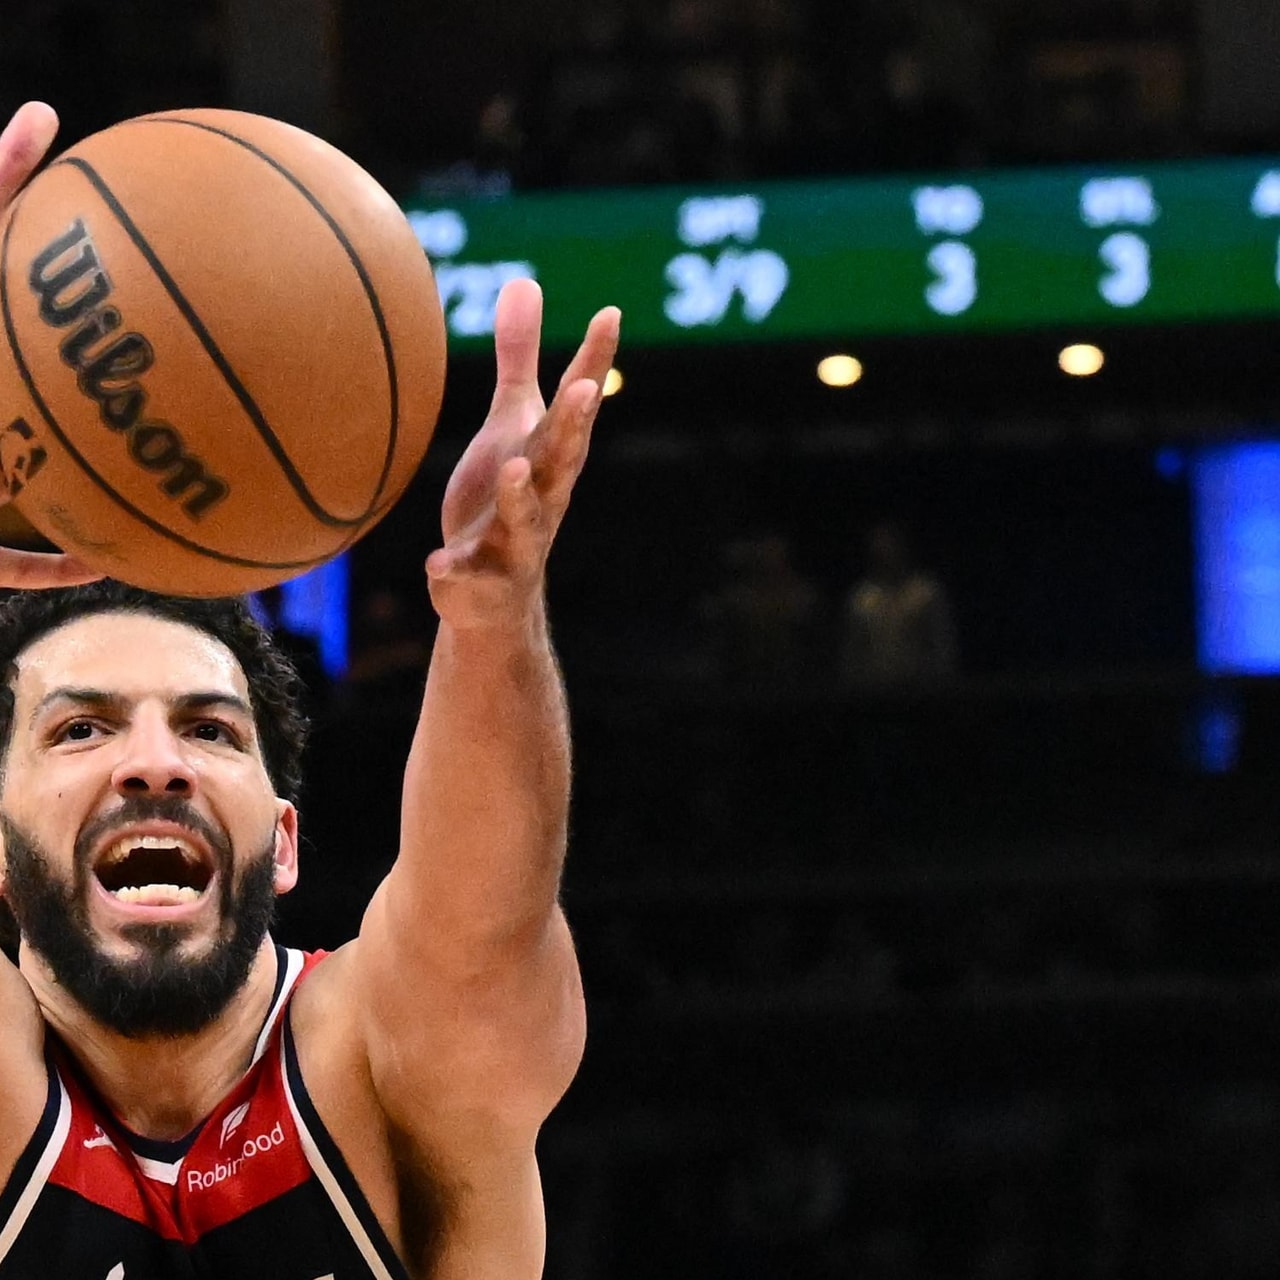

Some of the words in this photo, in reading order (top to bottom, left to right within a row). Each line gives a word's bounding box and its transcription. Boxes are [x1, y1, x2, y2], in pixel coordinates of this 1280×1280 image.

[924, 239, 977, 315] 3
[1098, 231, 1151, 307] 3
[28, 216, 231, 522] Wilson
[187, 1121, 285, 1193] Robinood
